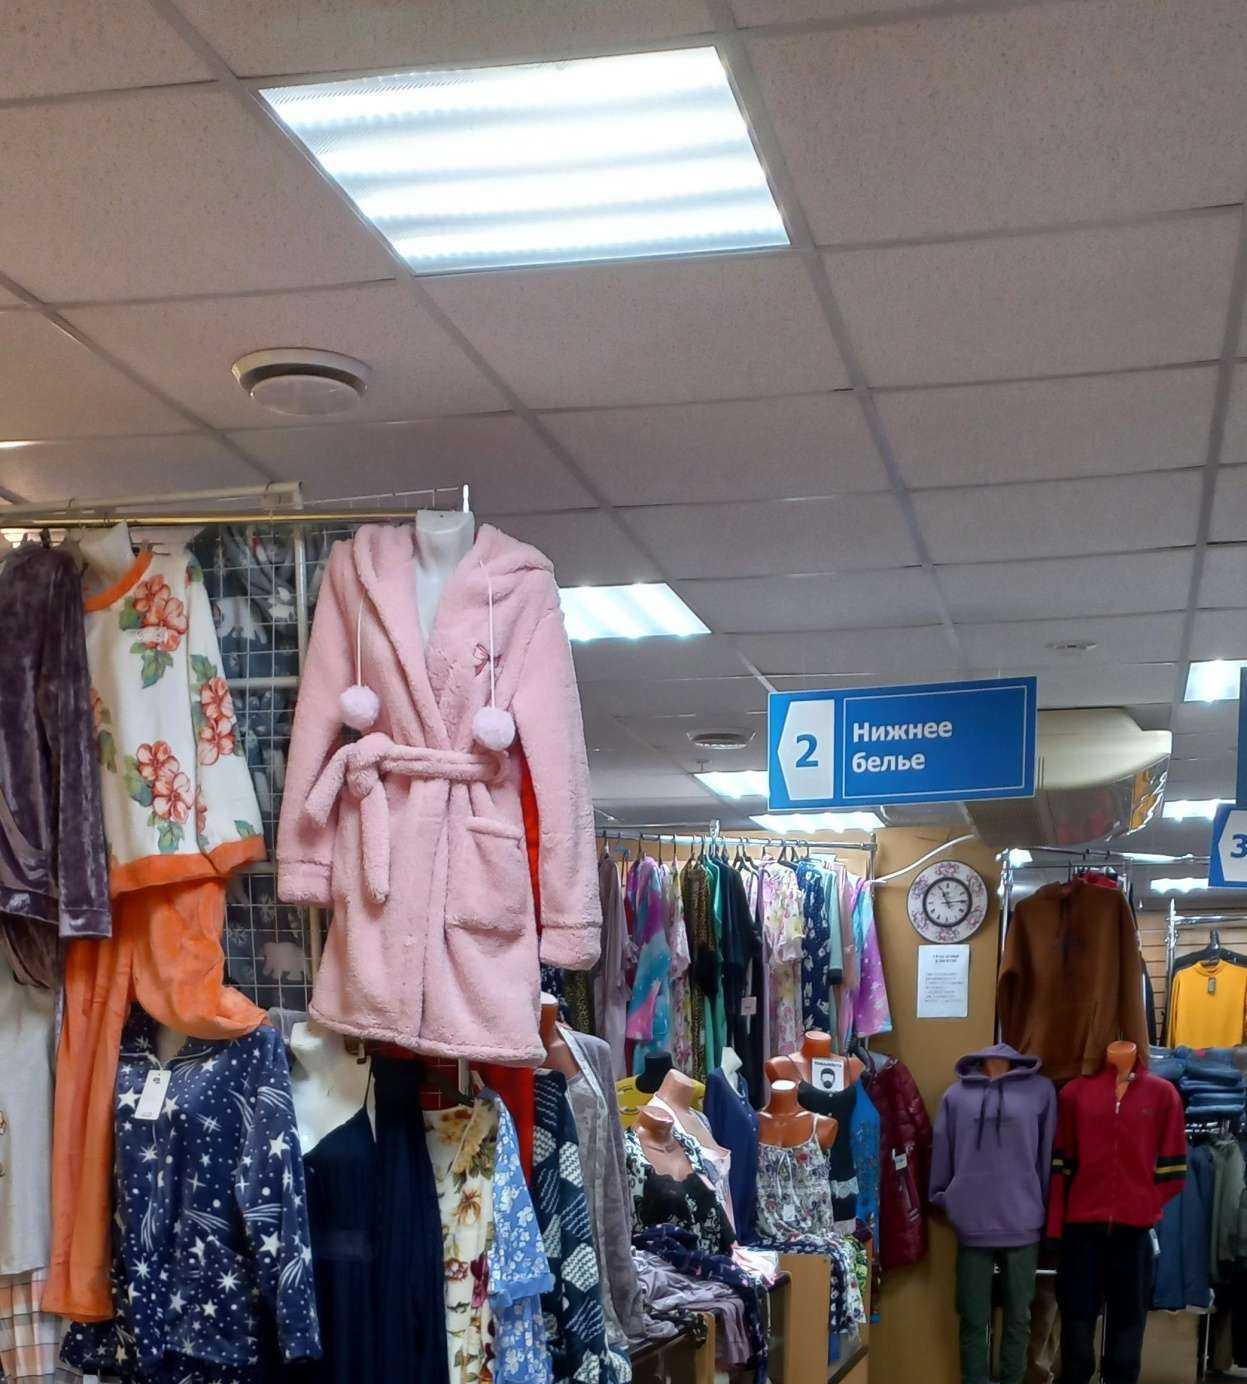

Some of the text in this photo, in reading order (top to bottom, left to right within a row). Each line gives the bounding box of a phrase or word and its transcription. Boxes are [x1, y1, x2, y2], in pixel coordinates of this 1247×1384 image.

[853, 720, 953, 743] Нижнее
[795, 733, 819, 768] 2
[852, 752, 926, 773] белье
[1230, 833, 1247, 858] 3
